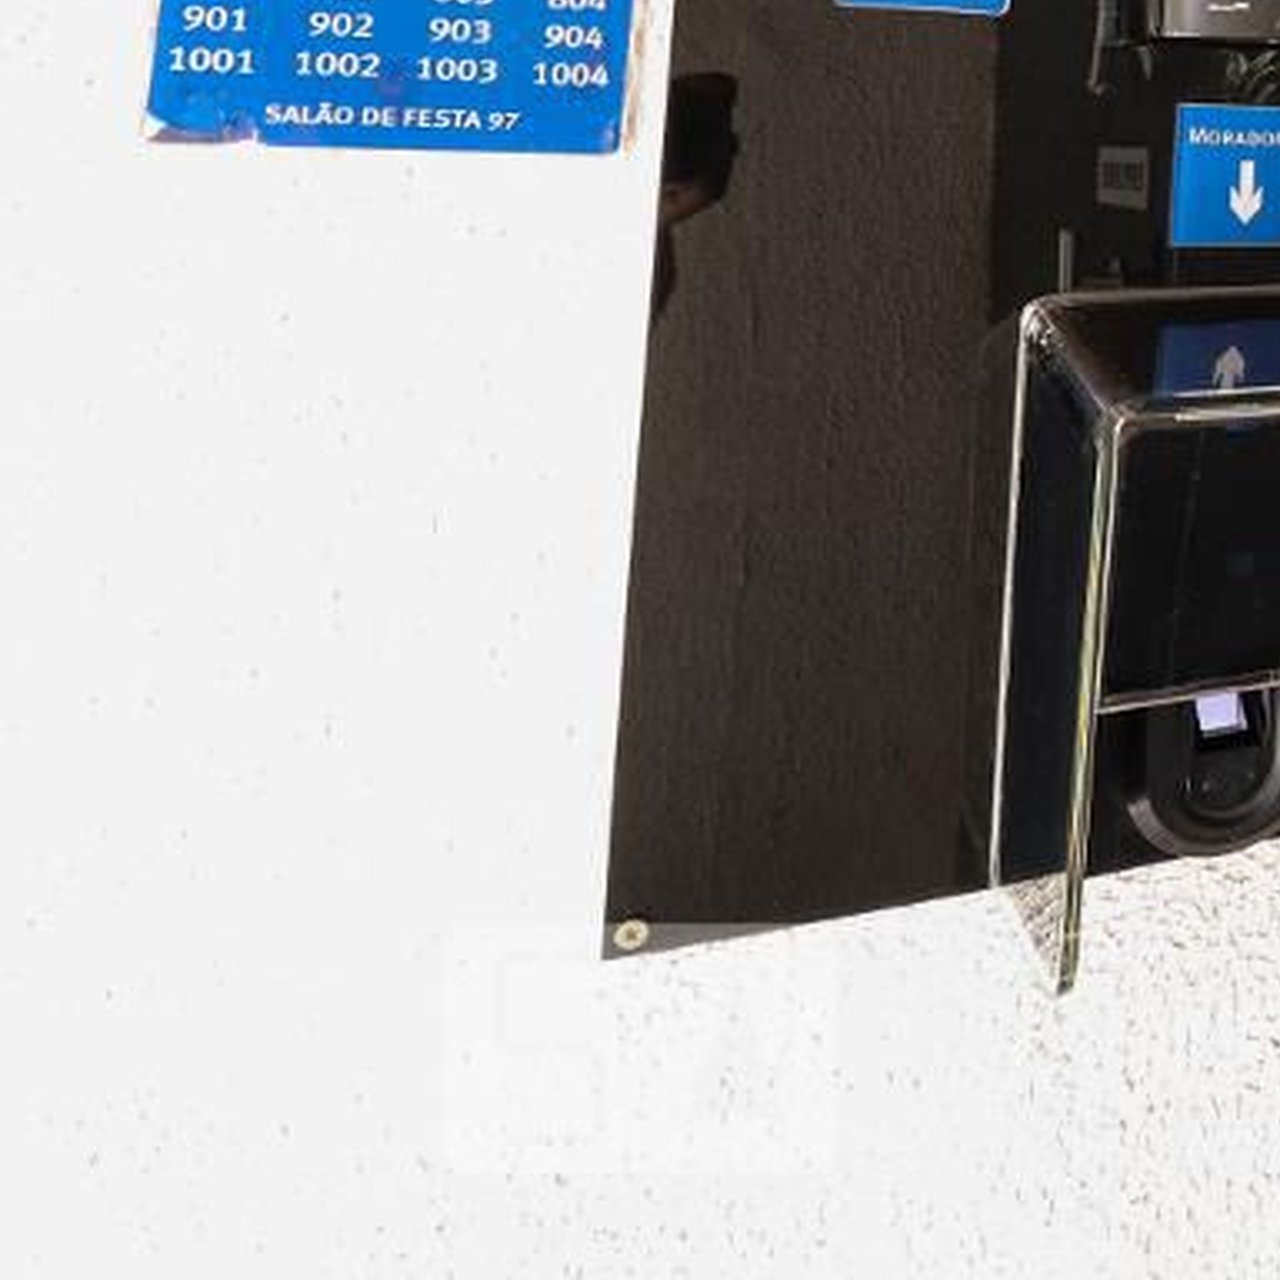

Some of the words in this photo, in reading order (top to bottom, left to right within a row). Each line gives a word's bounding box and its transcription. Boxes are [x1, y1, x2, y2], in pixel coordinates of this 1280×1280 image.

[183, 6, 248, 32] 901
[308, 13, 374, 39] 902
[429, 18, 492, 44] 903
[544, 25, 604, 50] 904
[169, 47, 256, 74] 1001
[295, 52, 382, 78] 1002
[416, 57, 498, 84] 1003
[532, 63, 610, 87] 1004
[265, 102, 355, 126] SALÃO
[361, 106, 396, 126] DE
[403, 108, 482, 129] FESTA
[489, 111, 521, 130] 97
